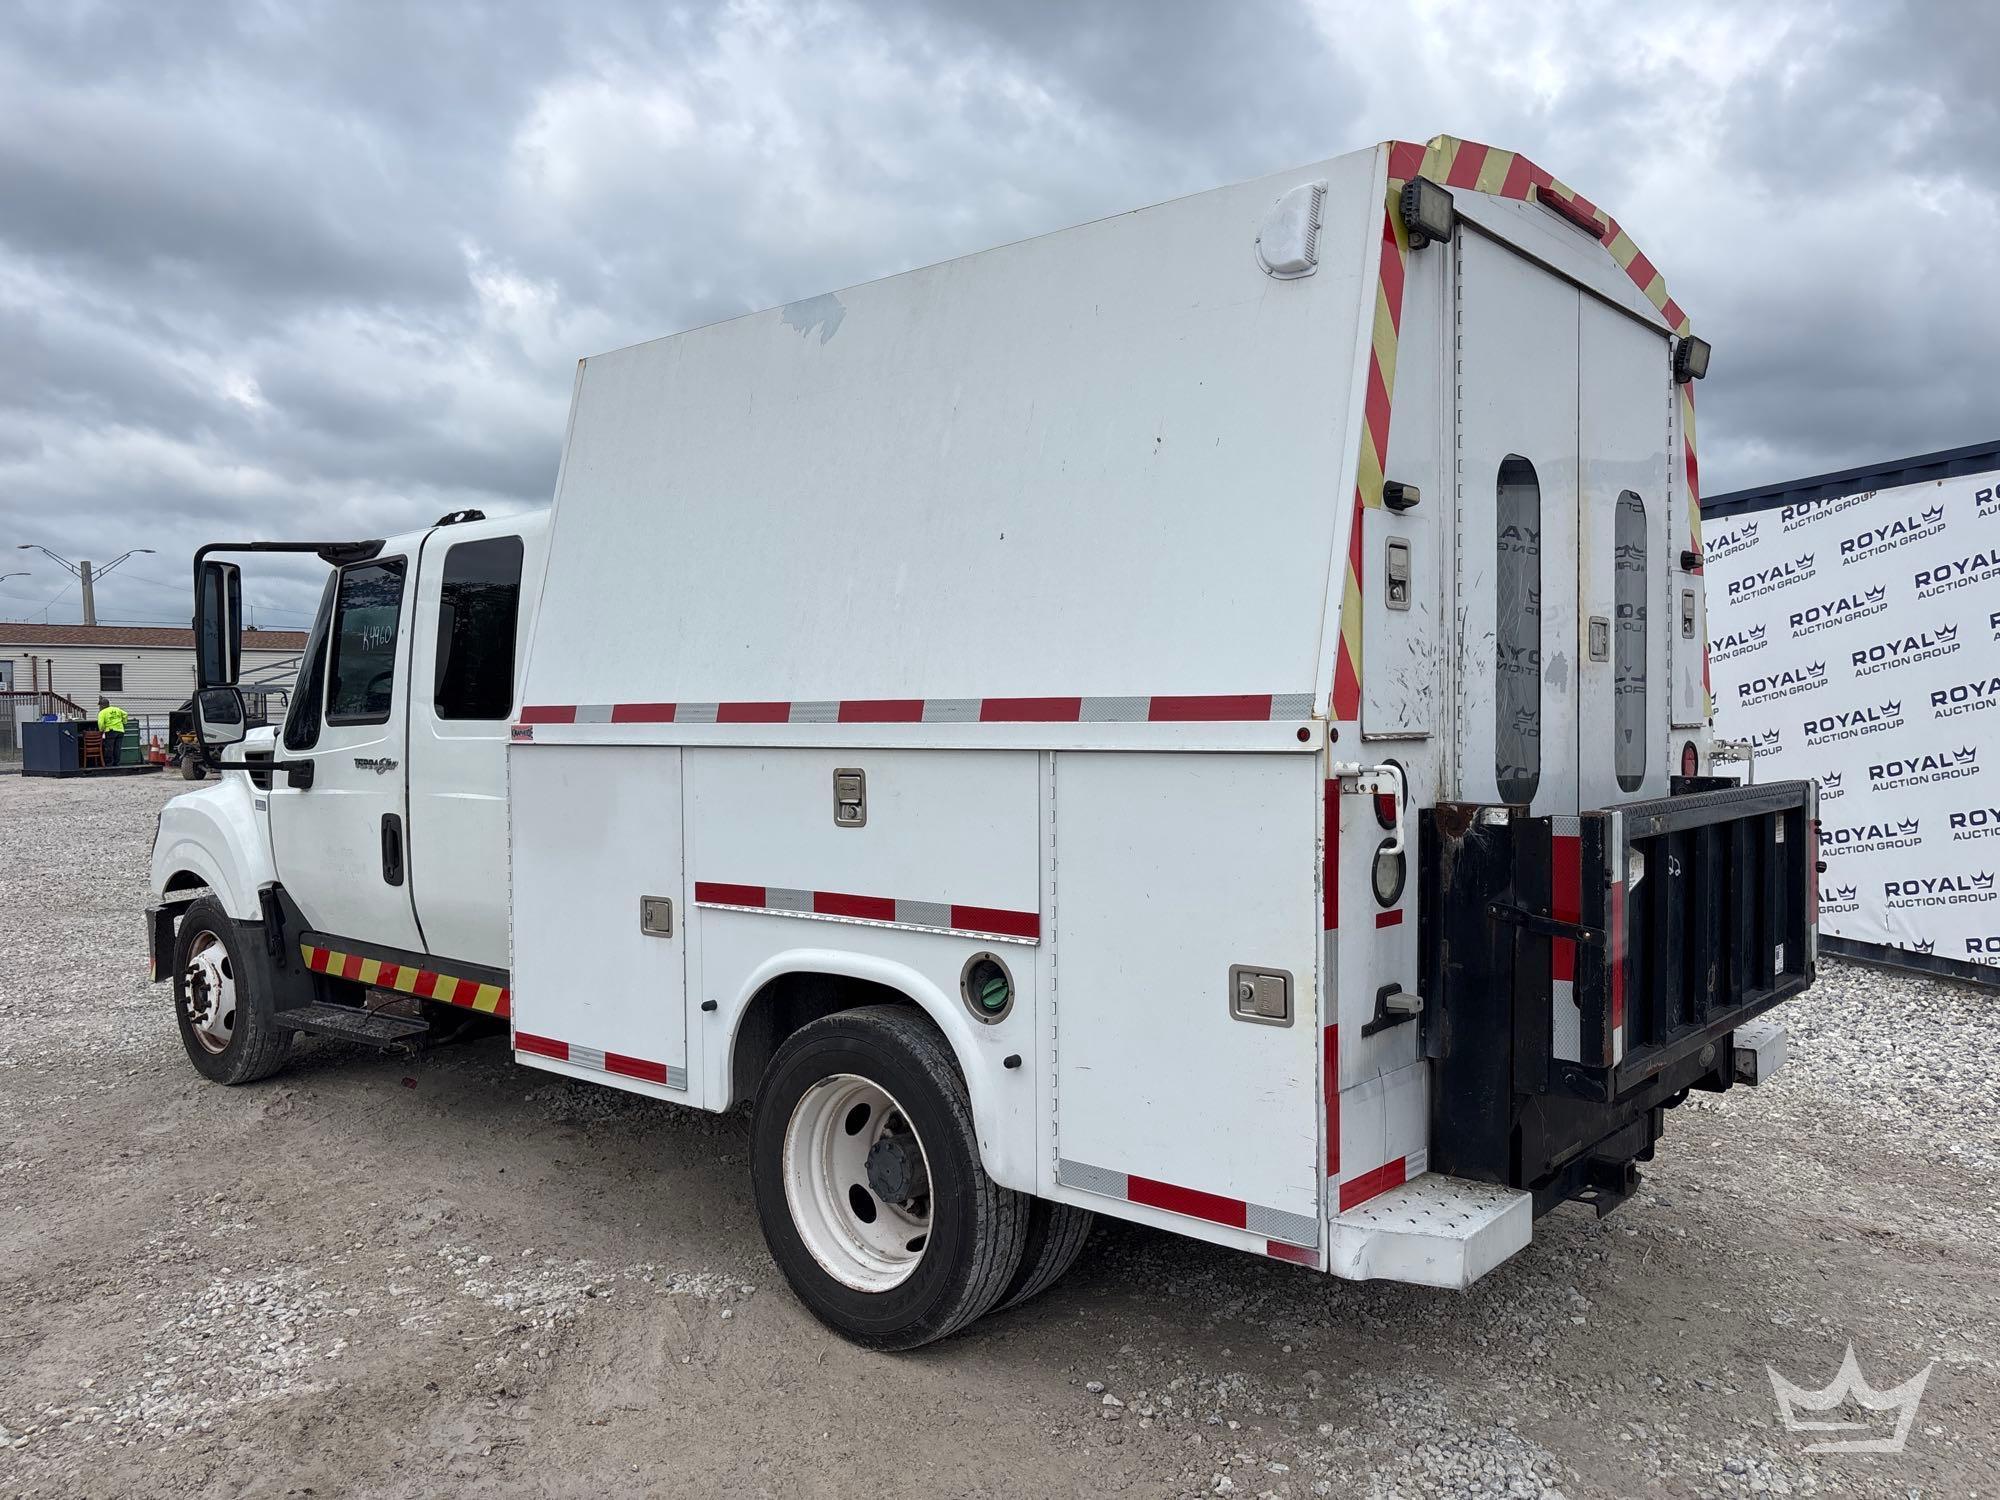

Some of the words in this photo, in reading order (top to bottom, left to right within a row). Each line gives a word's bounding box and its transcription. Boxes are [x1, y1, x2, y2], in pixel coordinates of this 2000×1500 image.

[1783, 508, 1833, 533] AUCTION
[1704, 532, 1741, 554] YAL
[1724, 538, 1760, 557] GROUP
[1840, 517, 1921, 555] ROYAL
[1842, 541, 1897, 566] AUCTION
[1899, 523, 1946, 546] GROUP
[1728, 563, 1795, 596] ROYAL
[1729, 584, 1776, 606] AUCTION
[1777, 570, 1816, 589] GROUP
[1917, 574, 1979, 600] AUCTION
[1790, 595, 1865, 628] ROYAL
[1792, 616, 1843, 638] AUCTION
[1844, 603, 1888, 623] GROUP
[363, 625, 392, 651] K4960
[1708, 632, 1749, 654] YAL
[1852, 633, 1935, 667] ROYAL
[1709, 652, 1731, 665] TION
[1732, 640, 1768, 658] GROUP
[1855, 656, 1911, 678] AUCTION
[1913, 643, 1961, 663] GROUP
[1738, 669, 1807, 698] ROYAL
[1741, 689, 1788, 708] AUCTION
[1789, 678, 1829, 696] GROUP
[1930, 677, 2000, 707] ROYA
[1934, 698, 1997, 719] AUCTION
[1804, 708, 1880, 736] ROYAL
[1807, 729, 1858, 747] AUCTION
[1860, 719, 1905, 735] GROUP
[1754, 746, 1782, 759] ROUP
[1869, 753, 1953, 780] ROYAL
[1872, 775, 1929, 792] AUCTION
[1931, 766, 1980, 782] GROUP
[1820, 790, 1844, 801] OUP
[1949, 808, 2000, 829] ROY
[1820, 823, 1897, 846] ROYAL
[1822, 843, 1875, 857] AUCTION
[1877, 837, 1922, 851] GROUP
[1953, 827, 2000, 841] AUCTIO
[1884, 876, 1971, 897] ROYAL
[1888, 896, 1946, 908] AUCTION
[1948, 892, 1998, 905] GROUP
